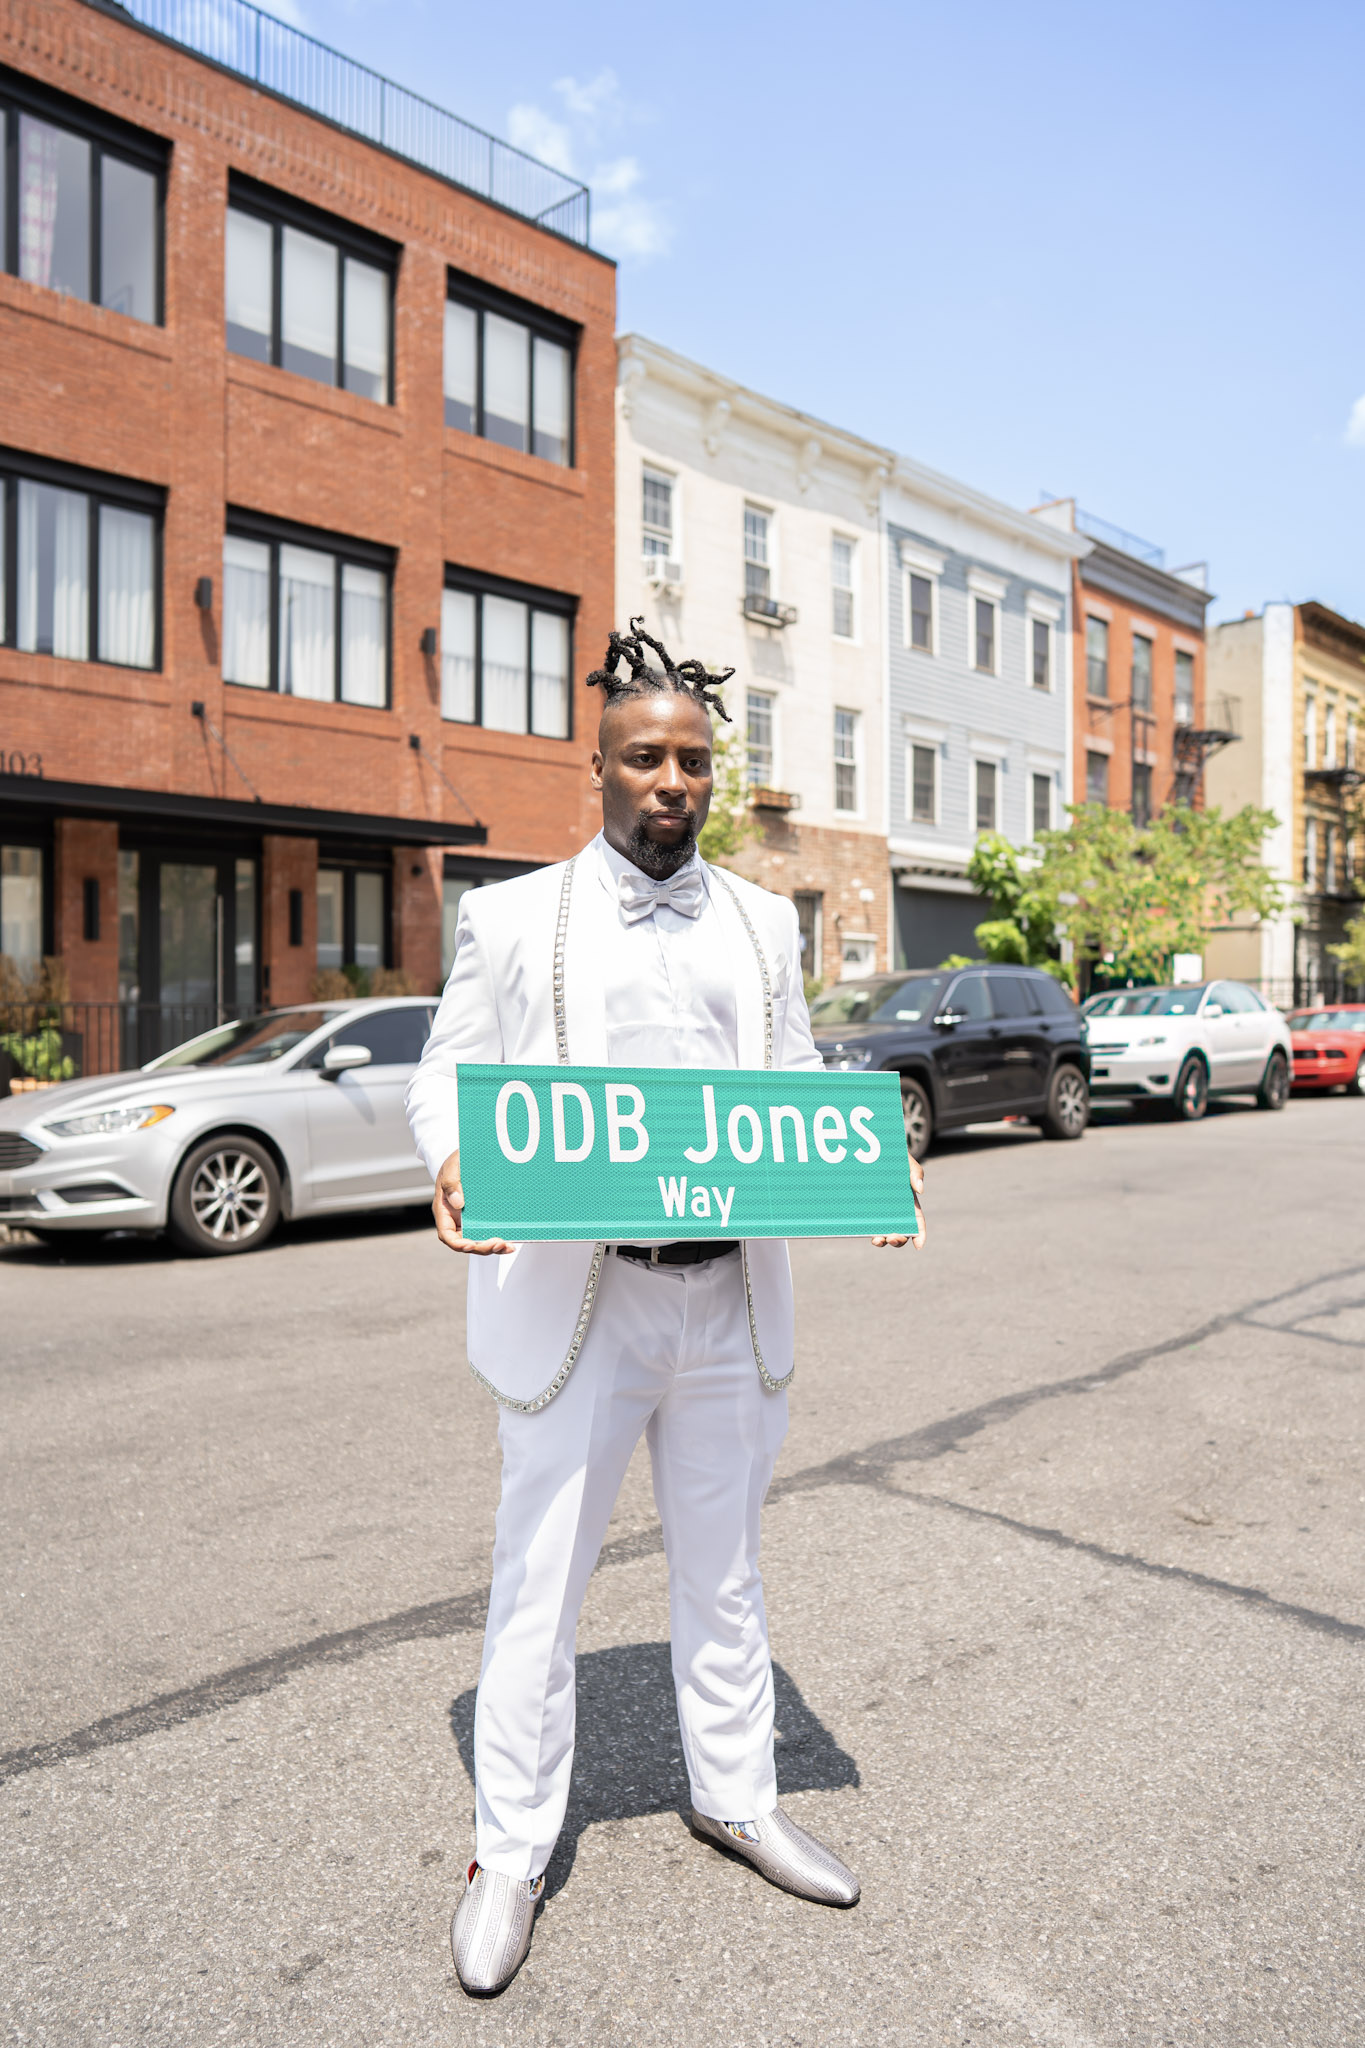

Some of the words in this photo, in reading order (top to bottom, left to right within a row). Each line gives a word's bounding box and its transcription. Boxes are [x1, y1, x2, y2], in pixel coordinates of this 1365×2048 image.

[495, 1080, 650, 1164] ODB
[683, 1084, 881, 1164] Jones
[657, 1175, 735, 1228] Way
